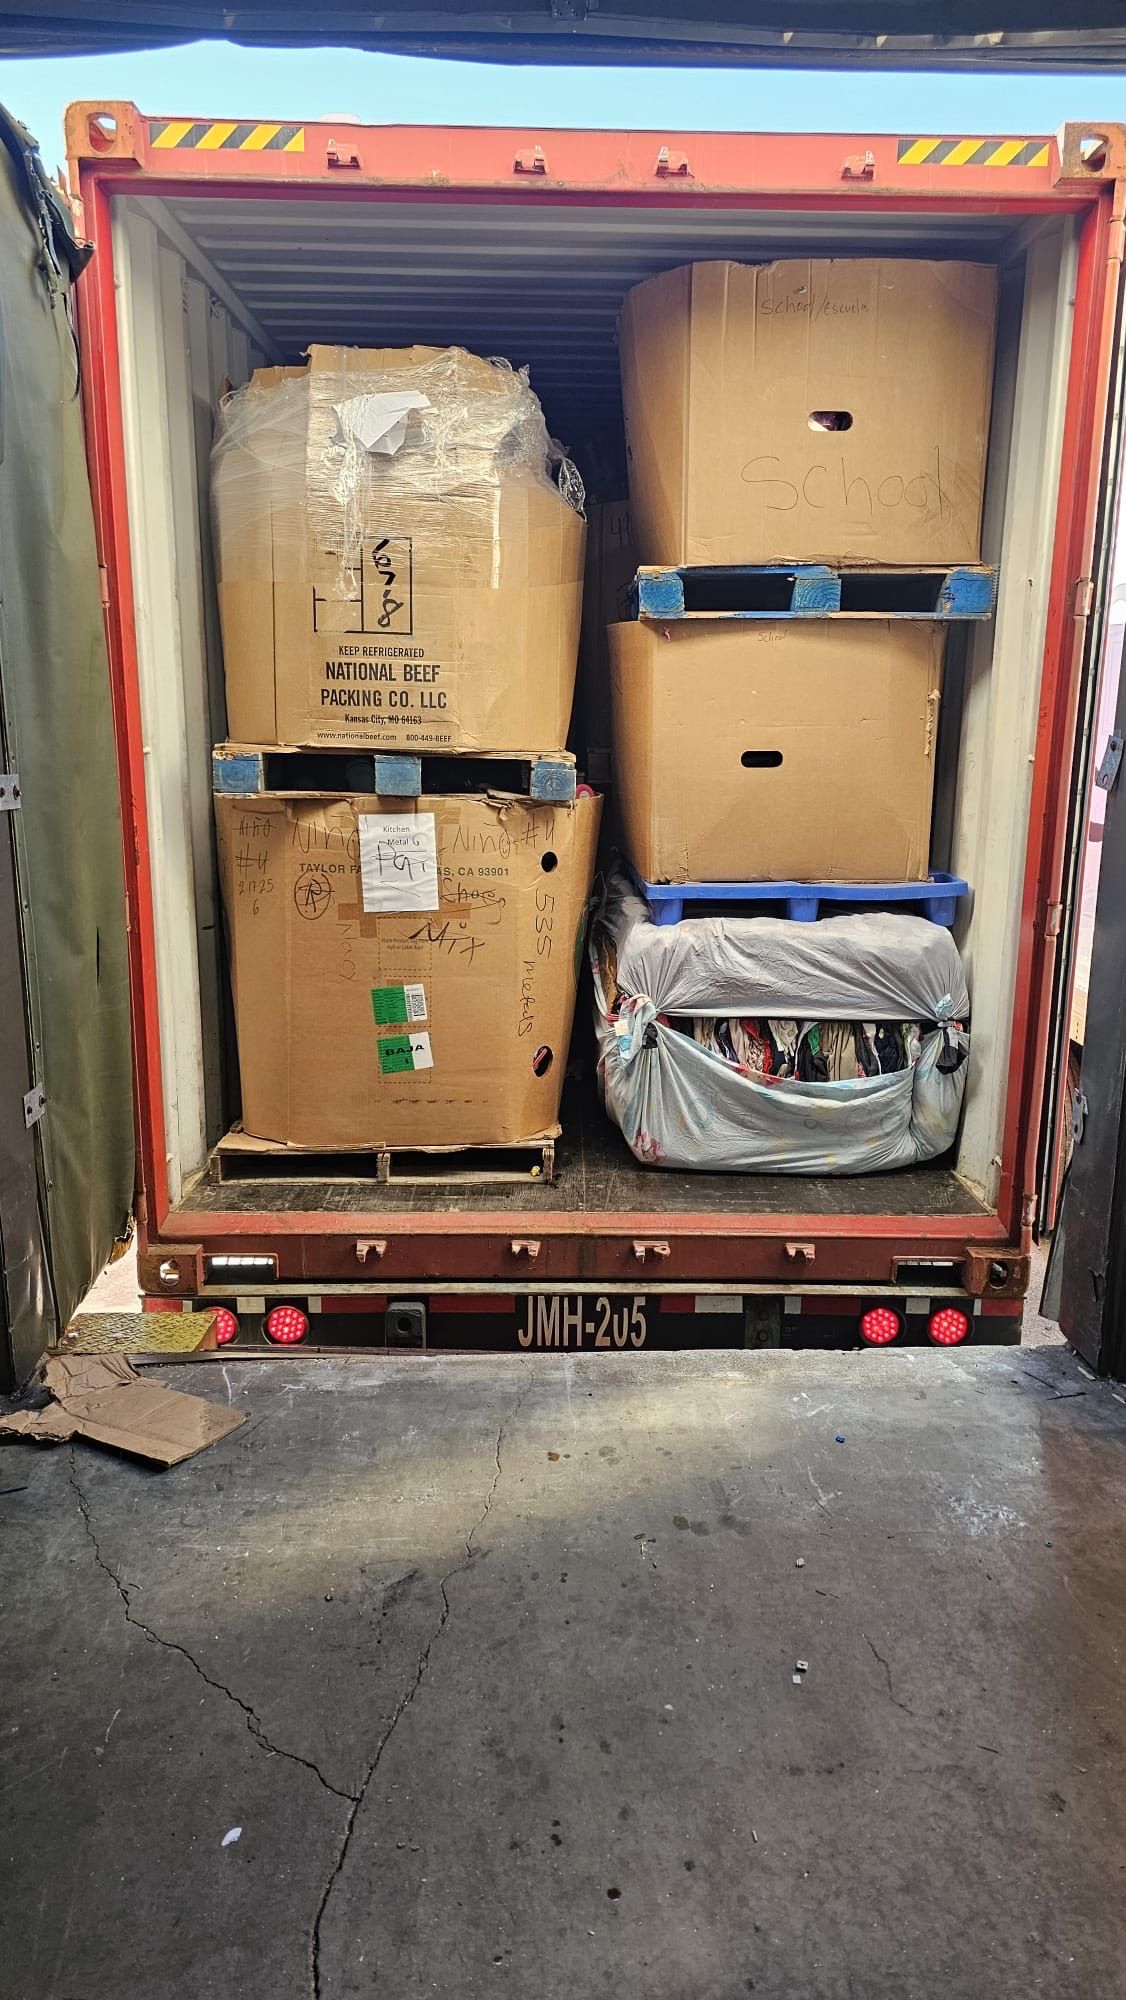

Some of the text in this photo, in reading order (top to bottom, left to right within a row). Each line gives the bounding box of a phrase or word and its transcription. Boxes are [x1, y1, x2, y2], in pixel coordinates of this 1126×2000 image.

[741, 446, 942, 520] School
[338, 645, 425, 658] KEEP REFRIGERATED
[325, 661, 441, 683] NATIONAL BEEF
[320, 688, 447, 709] PACKING CO. LLC
[344, 713, 422, 726] Kansas City, MO 64163
[316, 731, 452, 743] www.nationalbeef.com 800-449-BEEF
[387, 838, 409, 846] Metal
[299, 863, 345, 873] TAYLOR
[457, 867, 474, 877] CA
[478, 867, 509, 877] 93901
[535, 887, 555, 959] 535
[385, 1044, 425, 1057] BAJA
